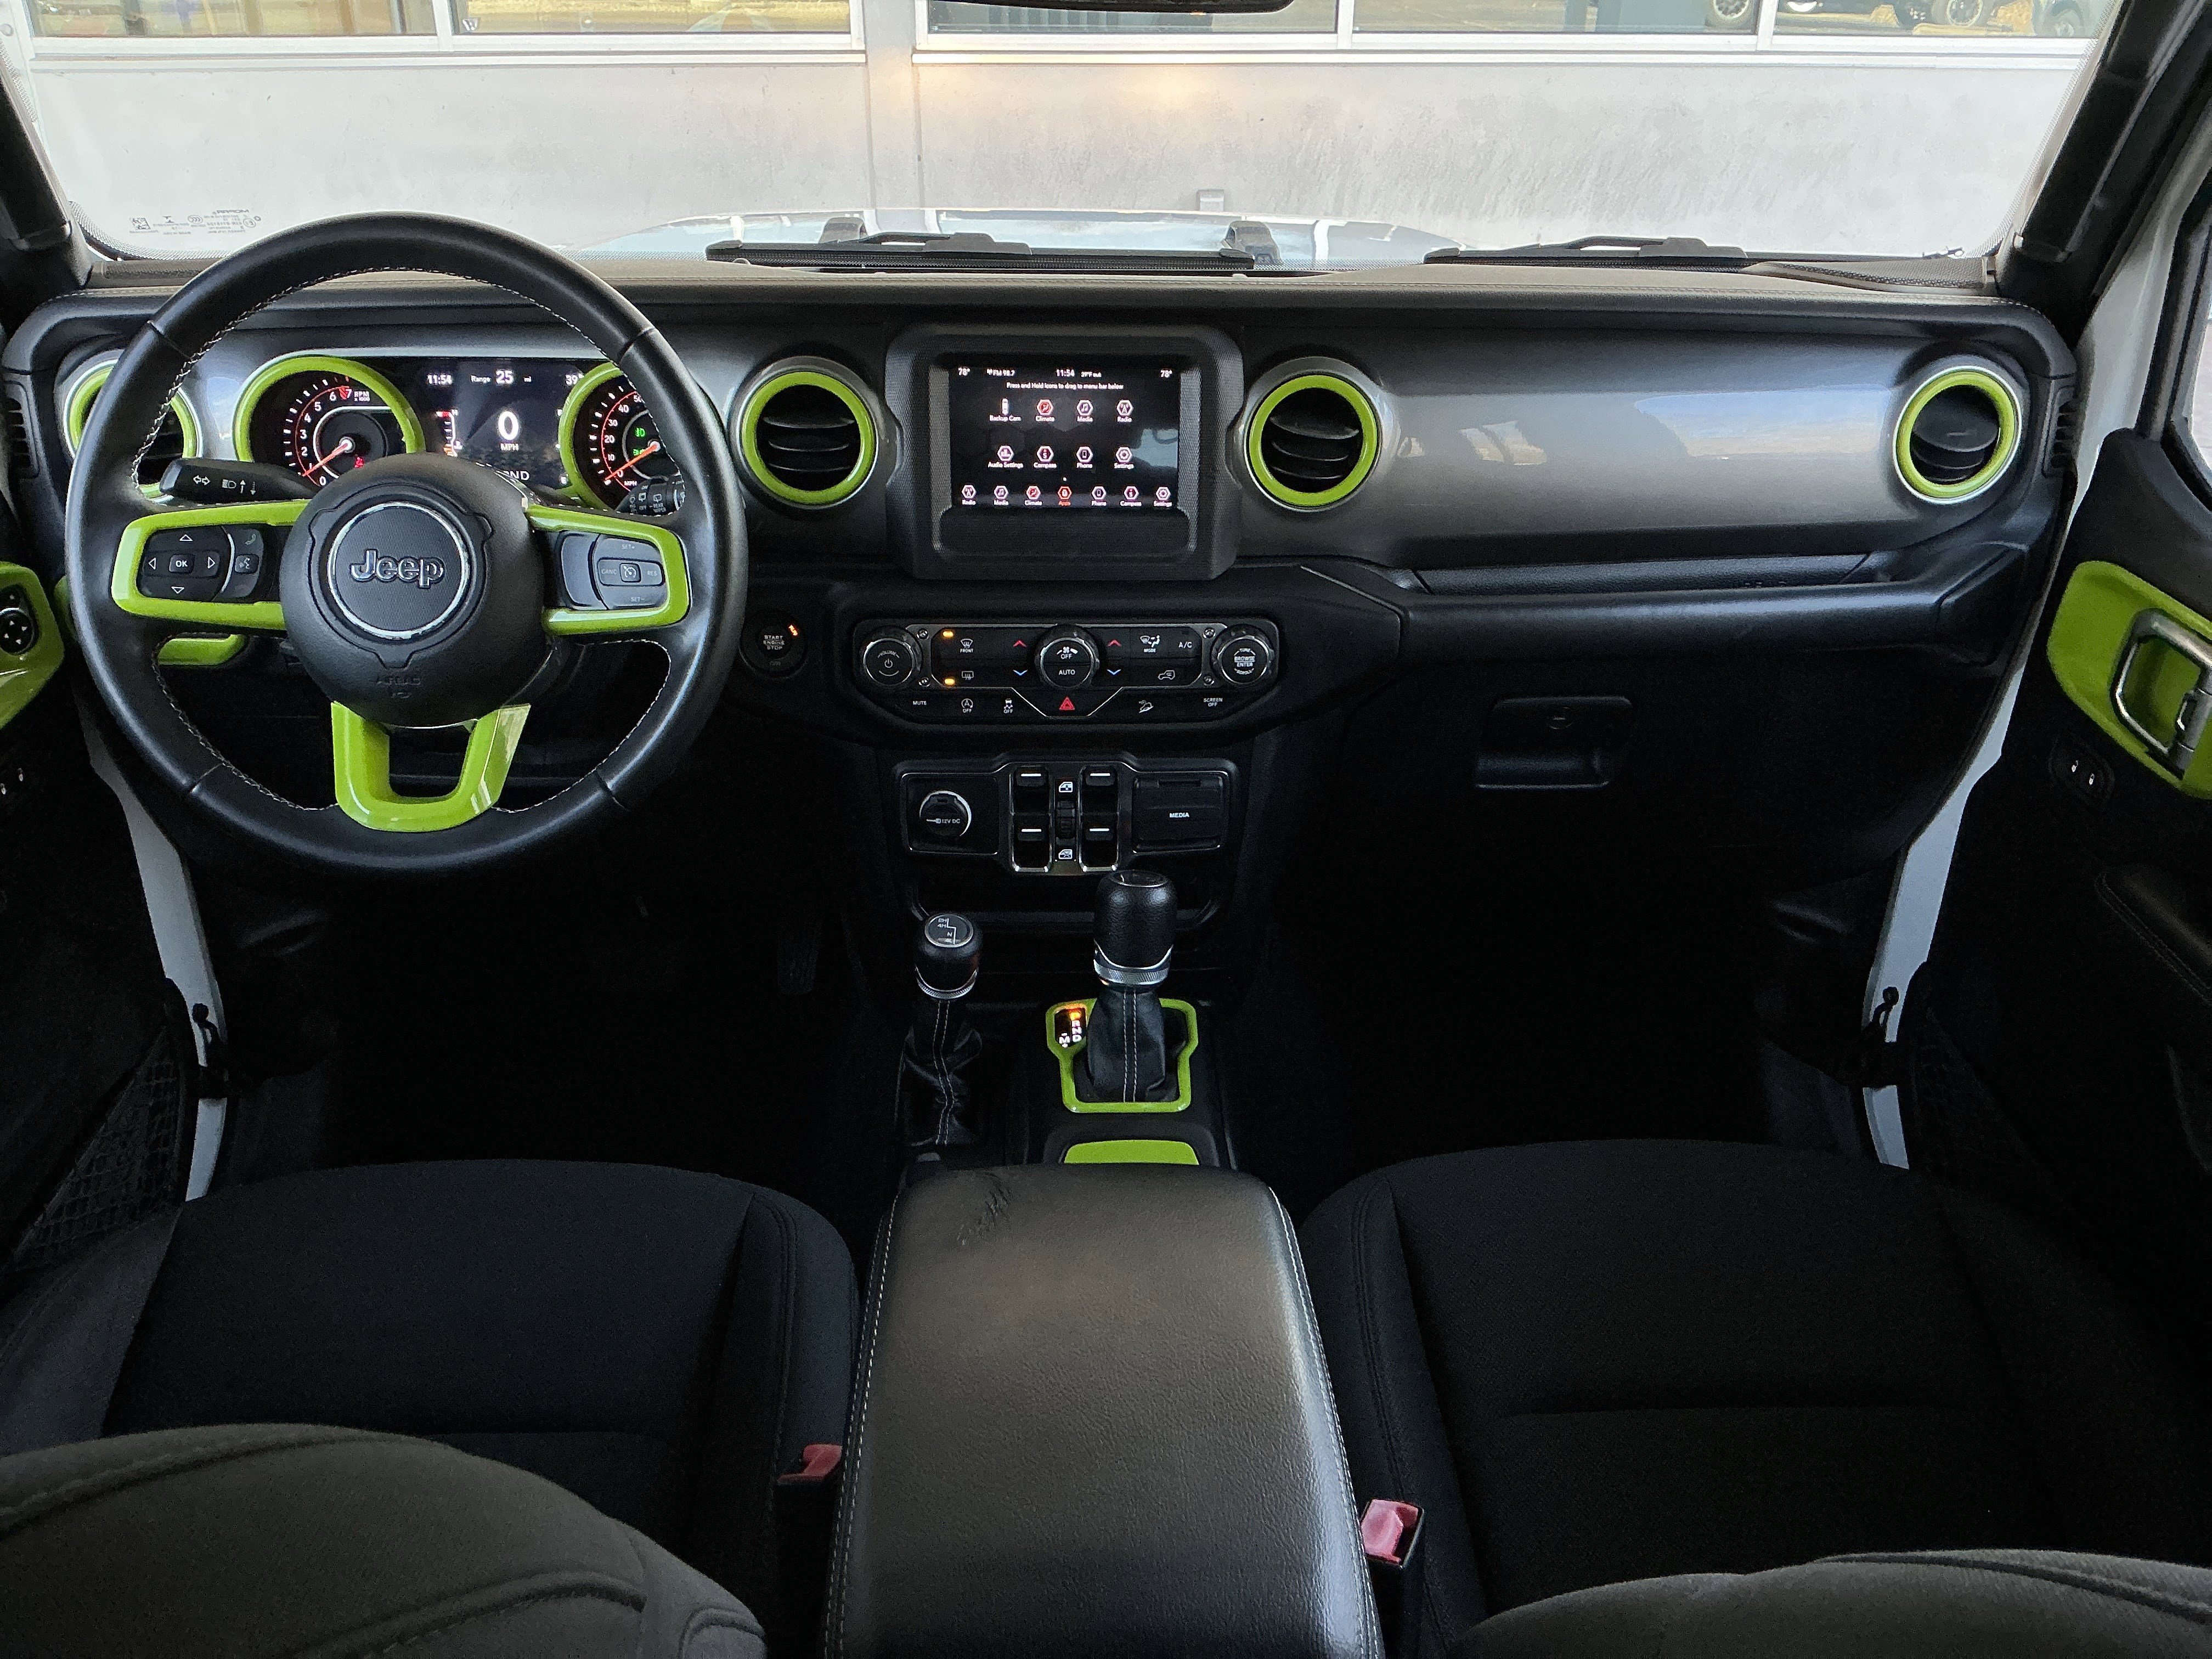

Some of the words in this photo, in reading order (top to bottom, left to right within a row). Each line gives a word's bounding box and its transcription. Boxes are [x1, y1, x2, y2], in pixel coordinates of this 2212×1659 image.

[495, 370, 514, 384] 25
[1056, 369, 1075, 377] 11:54
[427, 374, 453, 385] 11:54
[329, 391, 336, 401] 6
[345, 388, 352, 398] 7
[314, 402, 321, 411] 5
[618, 404, 629, 413] 40
[304, 413, 311, 423] 4
[498, 410, 520, 441] 0
[300, 430, 307, 439] 3
[604, 435, 615, 443] 20
[301, 447, 308, 456] 2
[500, 443, 519, 451] MPH
[319, 476, 326, 486] 0
[350, 549, 446, 589] Jeep
[1071, 1026, 1082, 1035] N
[1059, 1036, 1070, 1044] M
[1072, 1034, 1082, 1042] D
